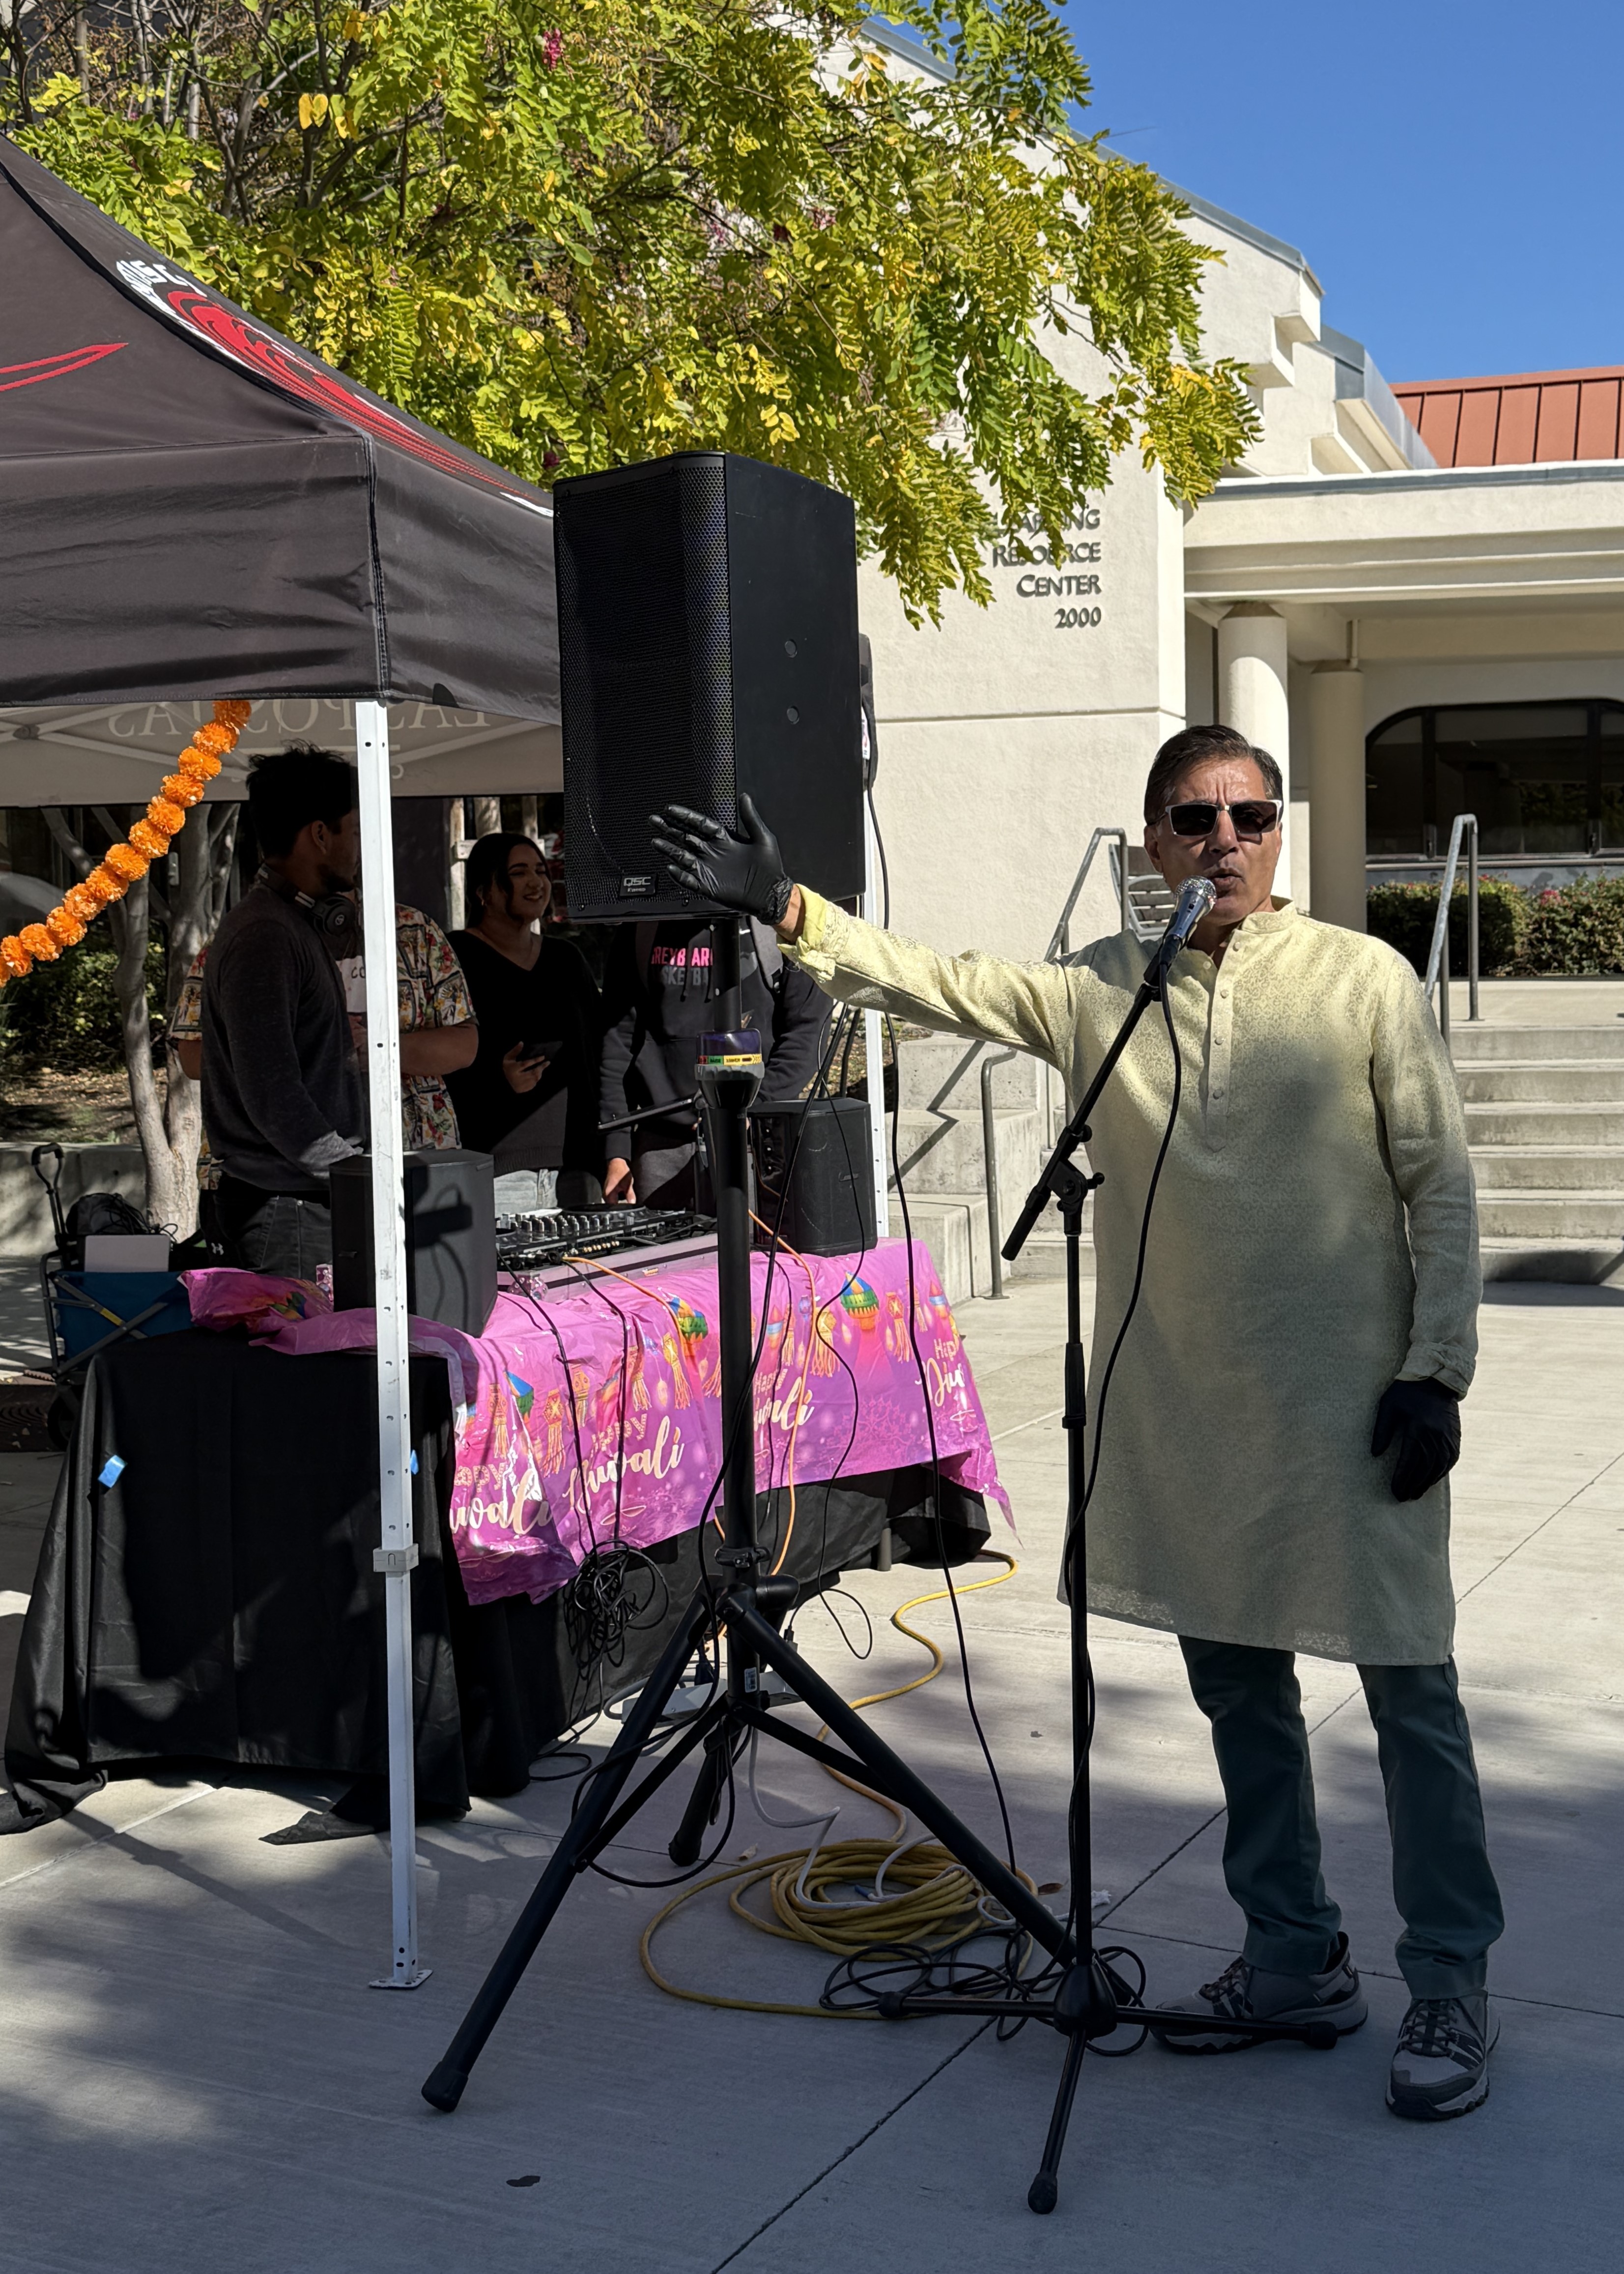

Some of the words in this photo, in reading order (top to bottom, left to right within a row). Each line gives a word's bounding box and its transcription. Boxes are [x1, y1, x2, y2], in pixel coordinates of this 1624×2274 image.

[993, 542, 1101, 568] REORCE
[1016, 574, 1102, 598] CENTER
[1054, 606, 1102, 629] 2000
[624, 877, 651, 887] QSC
